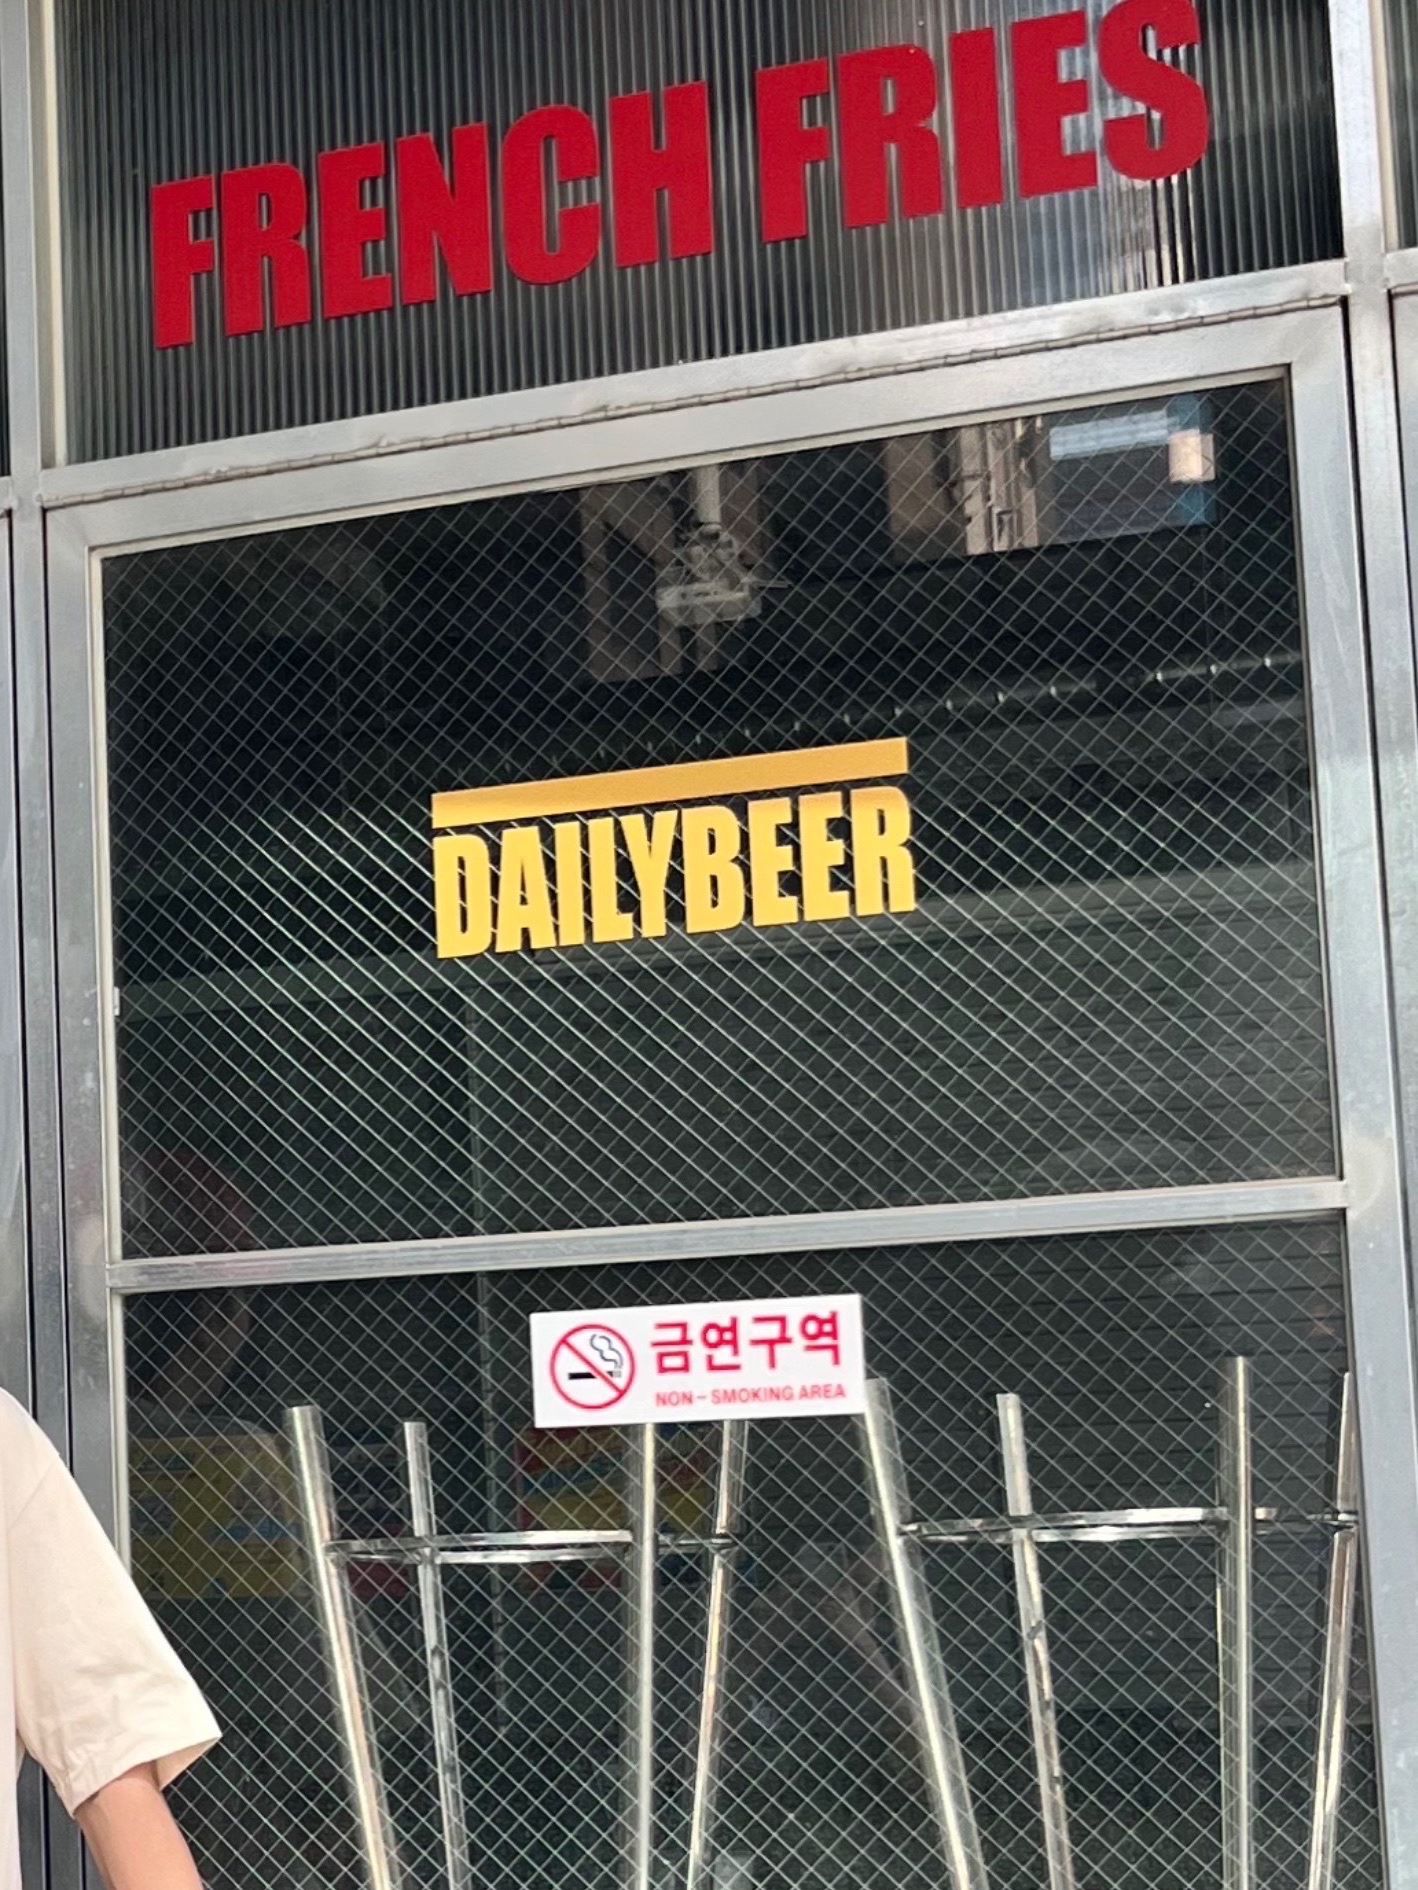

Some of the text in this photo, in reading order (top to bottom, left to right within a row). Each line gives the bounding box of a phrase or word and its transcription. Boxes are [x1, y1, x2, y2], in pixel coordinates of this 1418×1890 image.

[150, 0, 1209, 350] FRENCH FRIES
[432, 785, 917, 959] DAILYBEER
[649, 1310, 841, 1375] 금연구역
[798, 1383, 847, 1401] AREA
